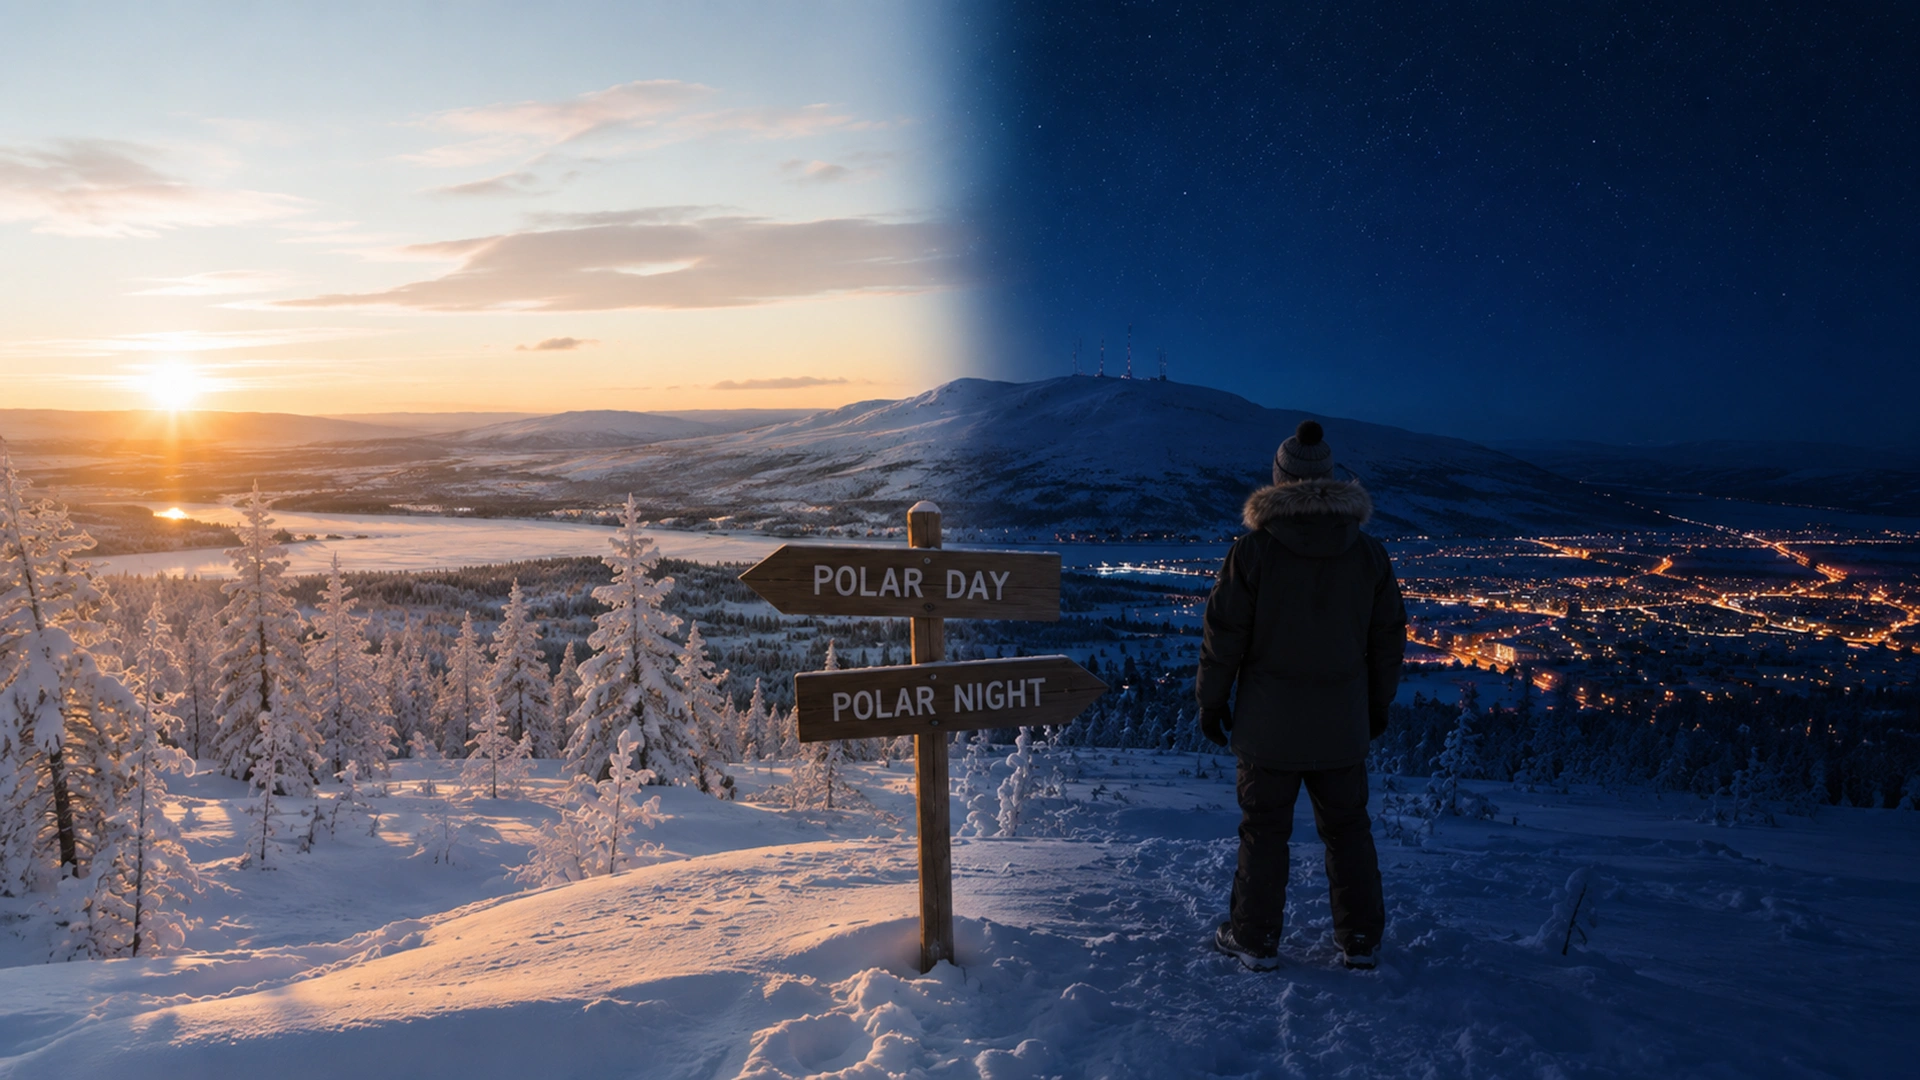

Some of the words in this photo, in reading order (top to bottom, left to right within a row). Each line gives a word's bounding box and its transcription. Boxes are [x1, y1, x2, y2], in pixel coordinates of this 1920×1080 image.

[814, 565, 924, 598] POLAR
[946, 569, 1010, 600] DAY
[832, 686, 937, 722] POLAR
[954, 677, 1046, 713] NIGHT
